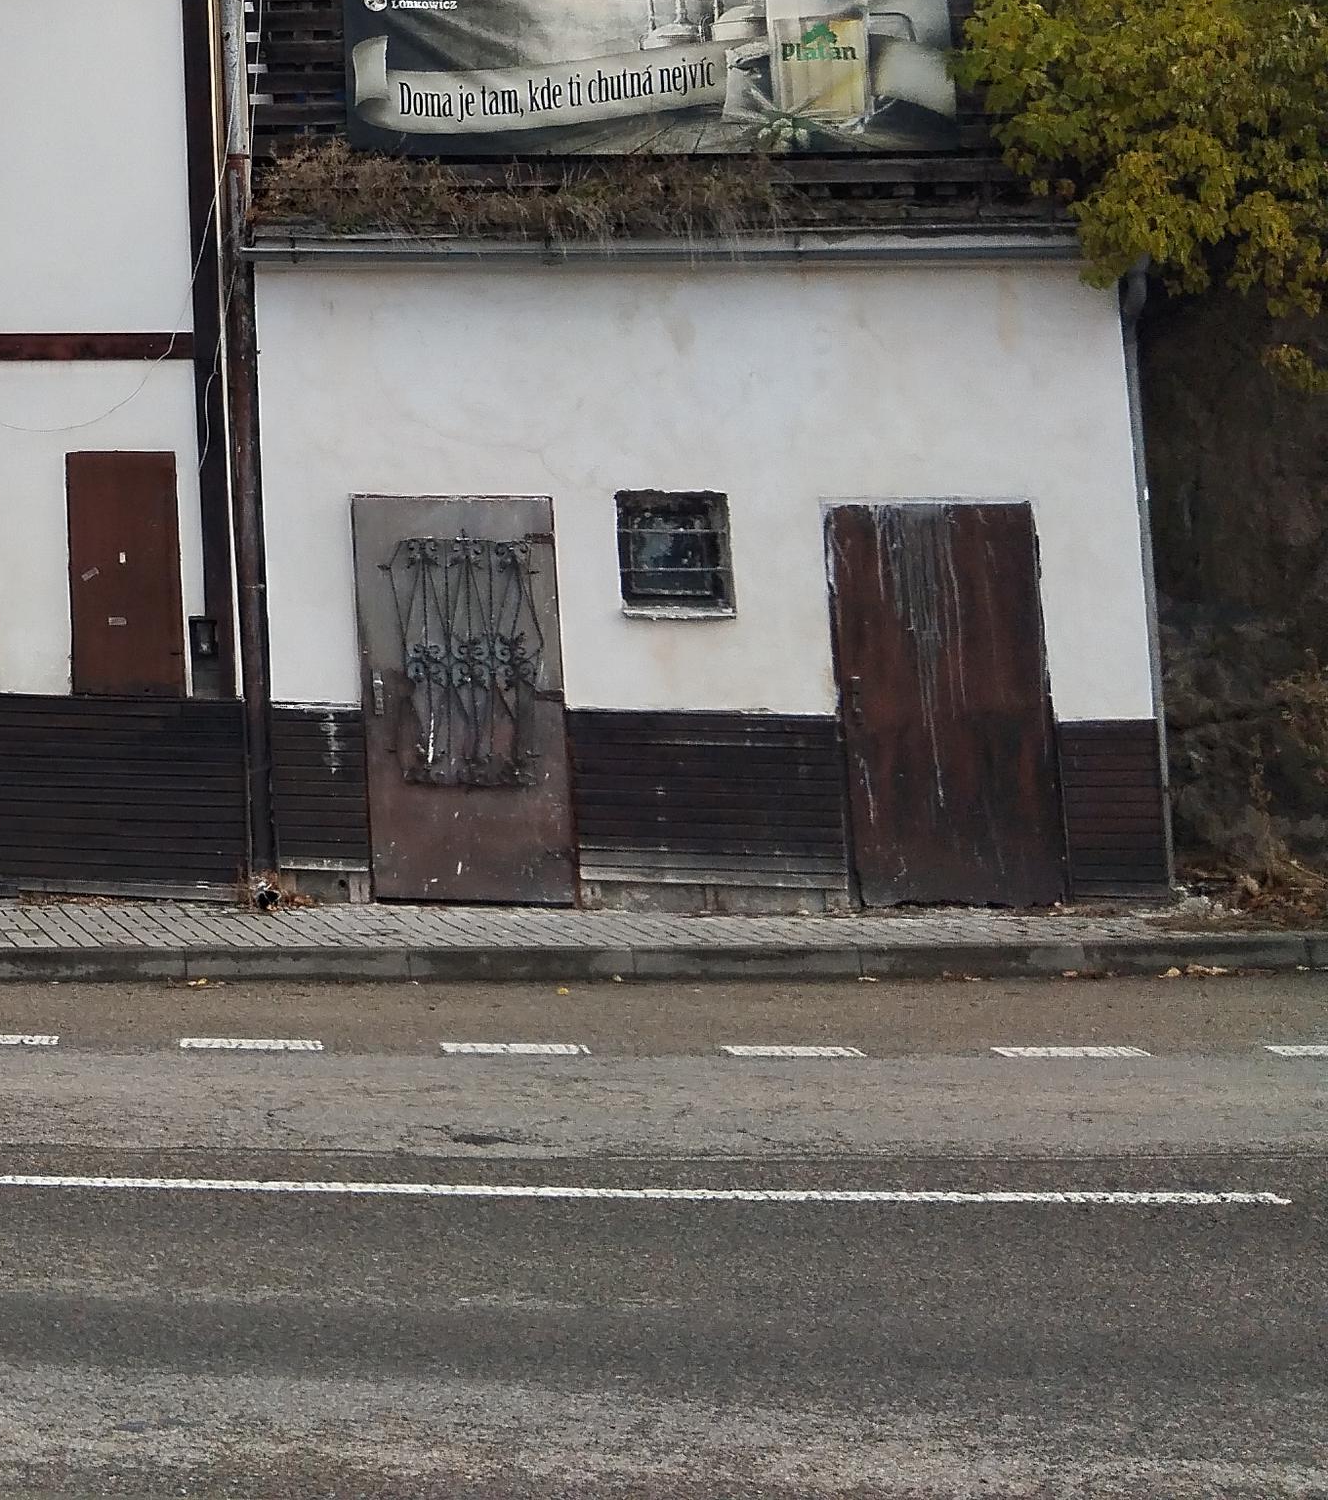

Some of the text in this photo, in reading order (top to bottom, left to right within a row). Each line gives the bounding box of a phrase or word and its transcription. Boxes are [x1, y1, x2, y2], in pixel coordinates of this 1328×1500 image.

[391, 0, 458, 11] LOBKOWICZ
[780, 43, 859, 61] Platan
[399, 56, 716, 122] Doma je tam, kde ti chutná nejvíc
